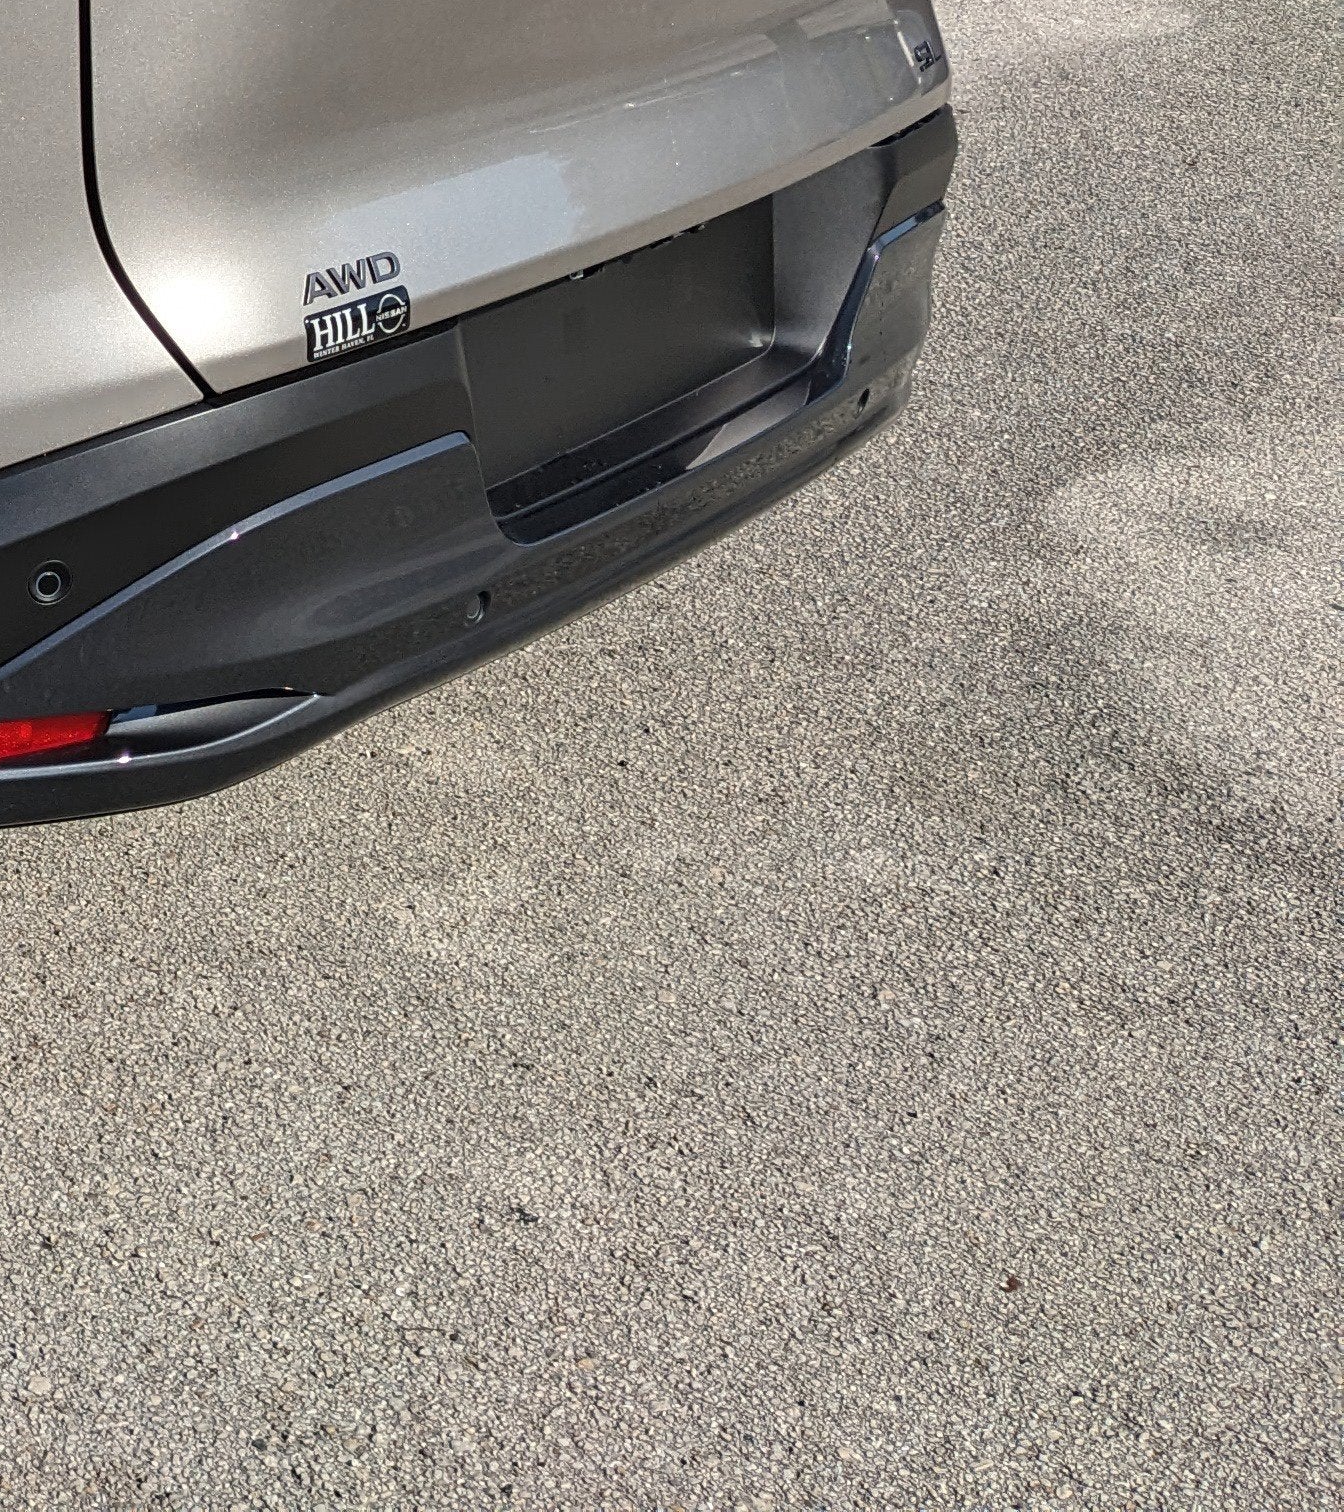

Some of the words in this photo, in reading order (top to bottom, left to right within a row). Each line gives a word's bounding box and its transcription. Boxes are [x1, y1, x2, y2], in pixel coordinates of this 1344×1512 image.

[303, 252, 400, 306] AWD
[310, 303, 375, 351] HILL
[376, 305, 407, 321] NISSAN
[314, 345, 339, 358] WINTER
